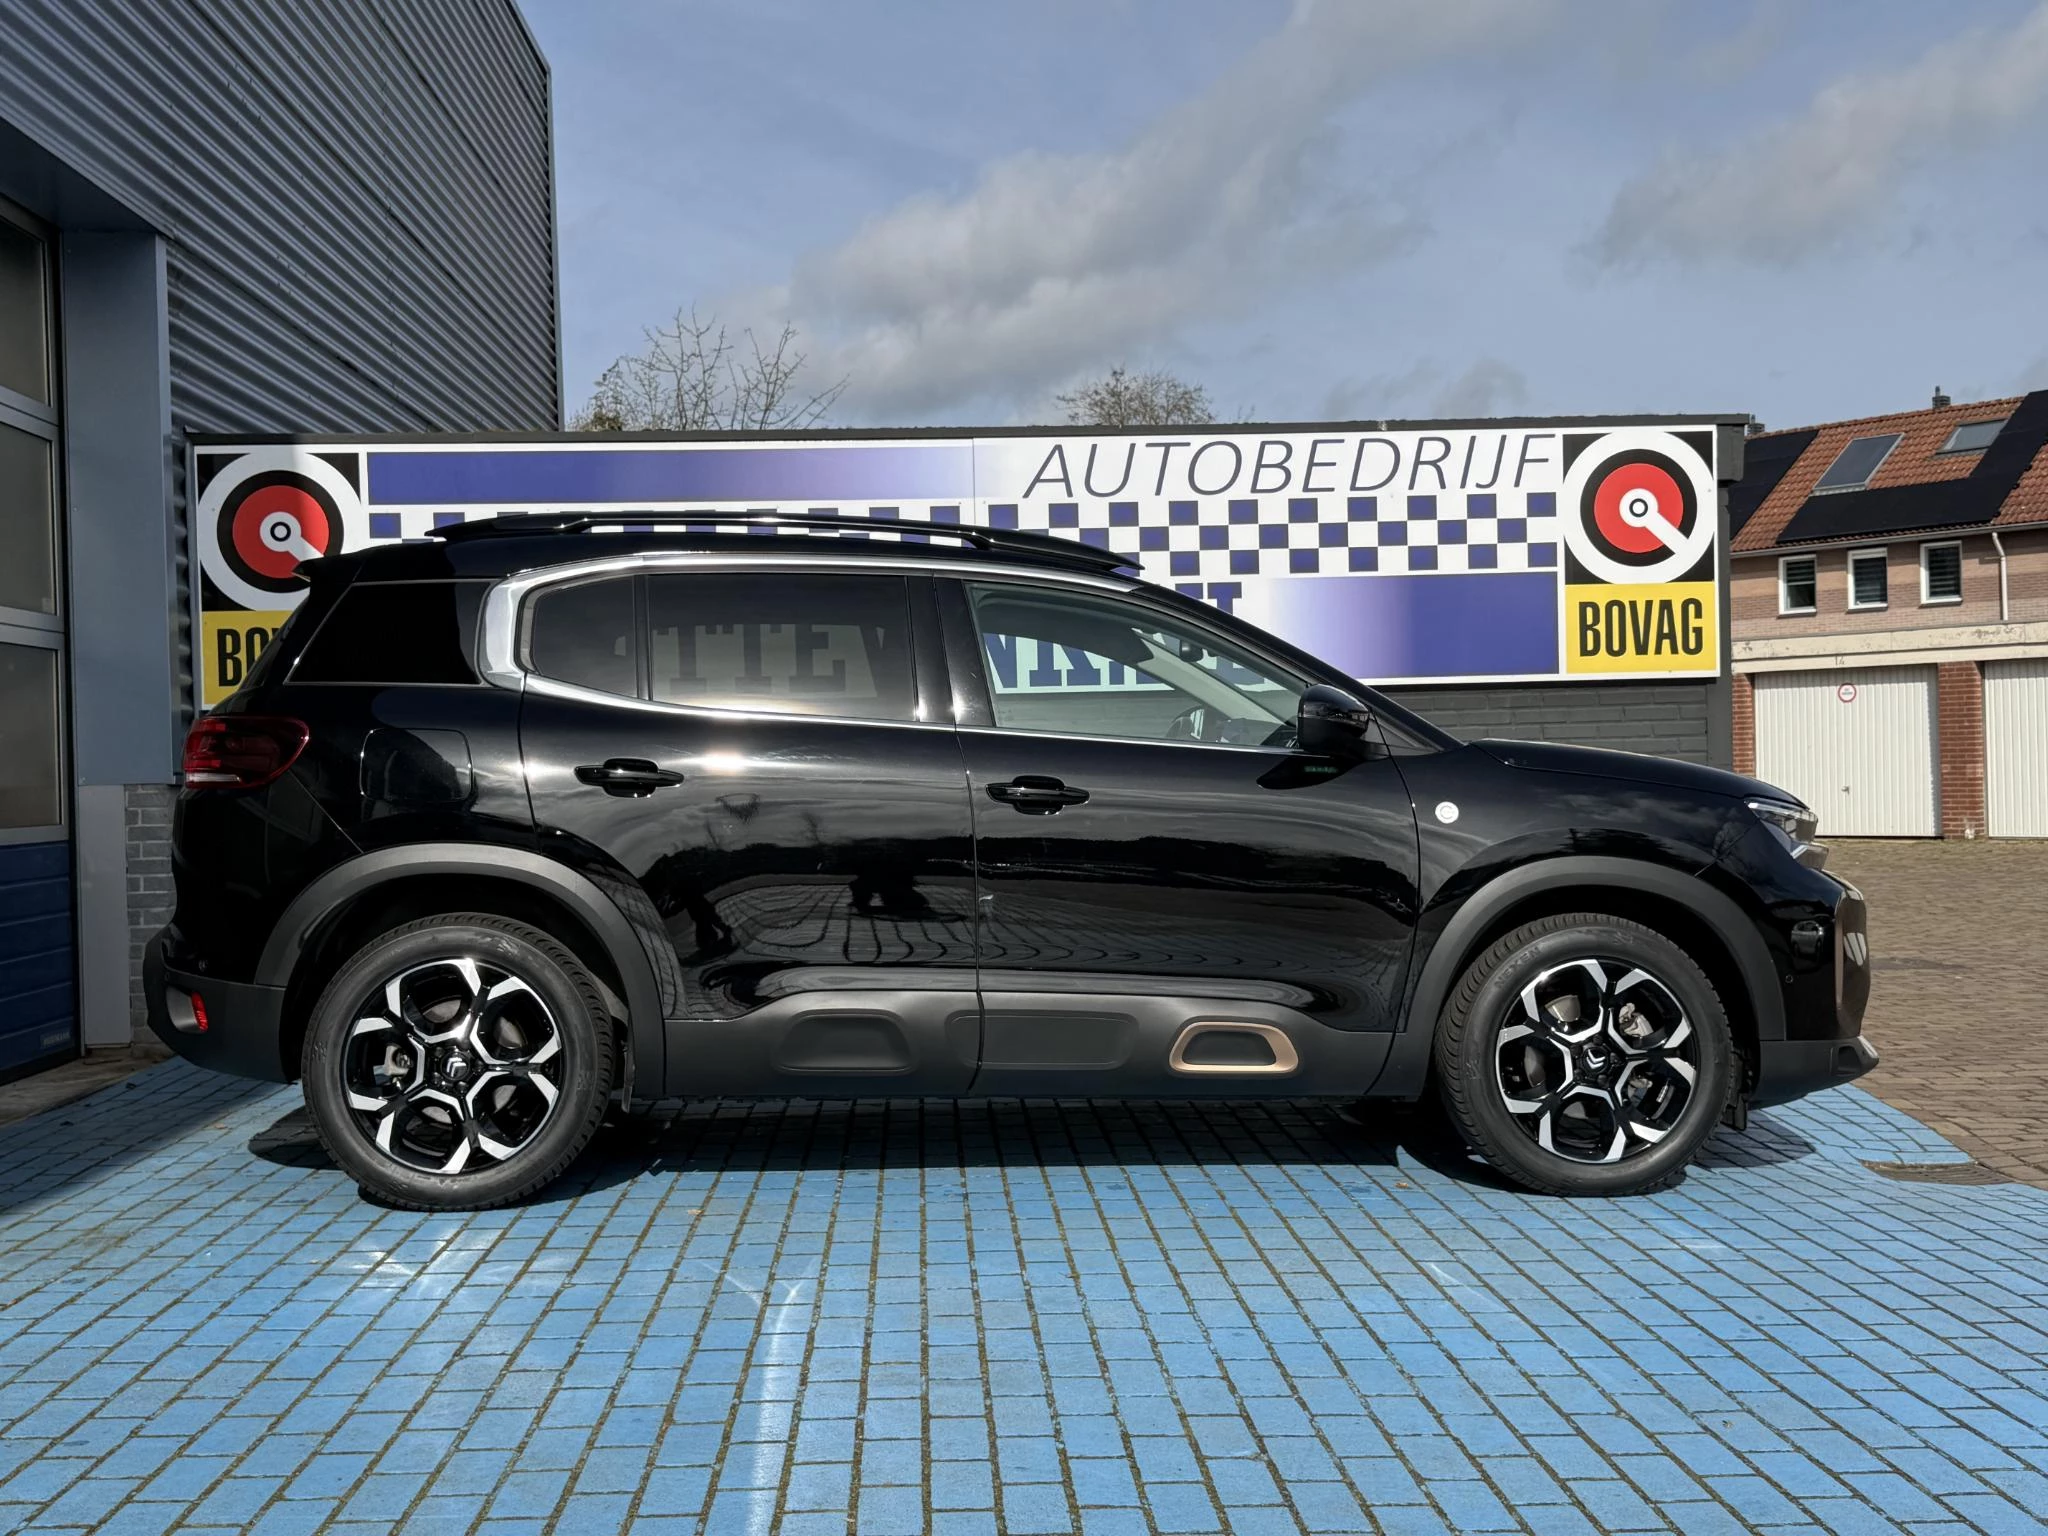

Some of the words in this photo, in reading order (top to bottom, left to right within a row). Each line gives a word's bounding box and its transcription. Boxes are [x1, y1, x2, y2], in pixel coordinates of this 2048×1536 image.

[1023, 433, 1556, 498] AUTOBEDRIJF
[217, 627, 281, 687] BO
[1578, 598, 1703, 657] BOVAG
[1494, 946, 1542, 988] NEXEN
